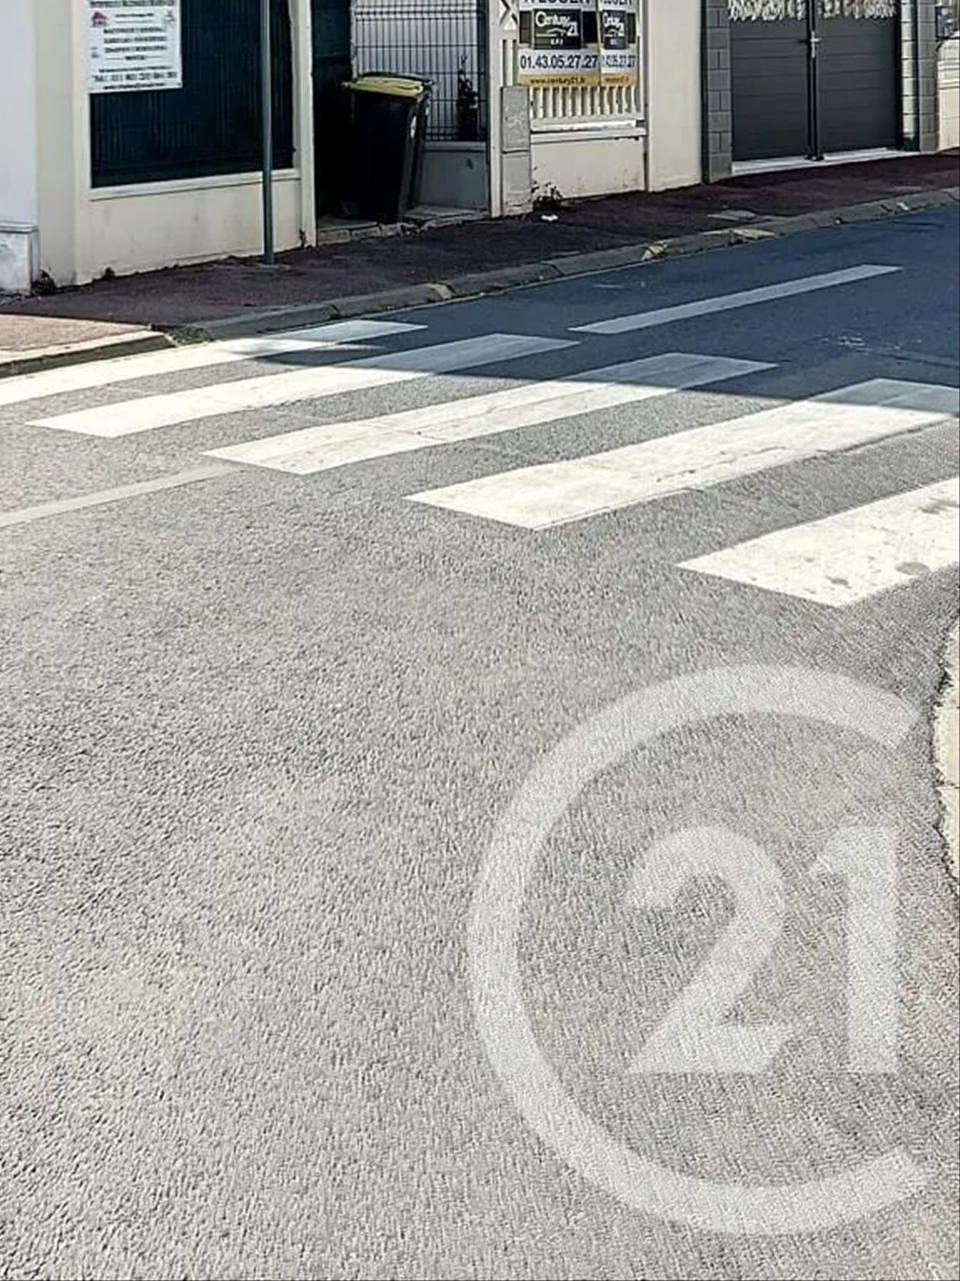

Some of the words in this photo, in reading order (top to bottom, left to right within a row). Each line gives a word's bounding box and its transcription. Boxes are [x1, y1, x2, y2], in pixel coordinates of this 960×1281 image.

[536, 11, 570, 27] Century
[566, 22, 579, 37] 21
[520, 55, 598, 69] 01.43.05.27.27
